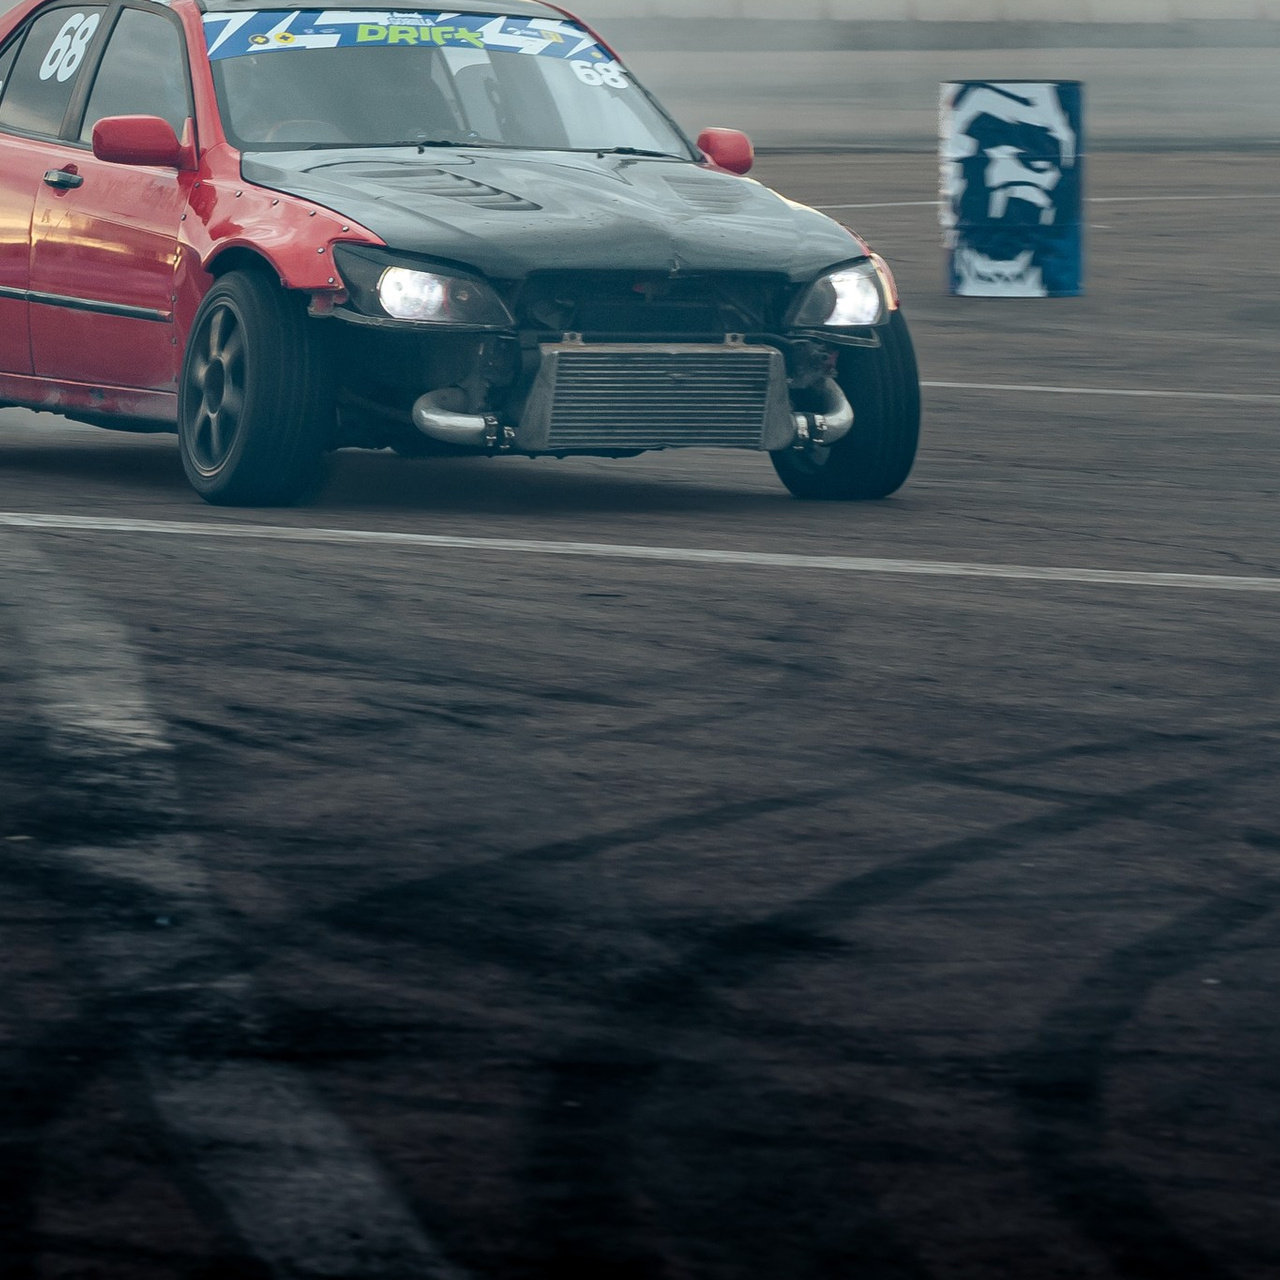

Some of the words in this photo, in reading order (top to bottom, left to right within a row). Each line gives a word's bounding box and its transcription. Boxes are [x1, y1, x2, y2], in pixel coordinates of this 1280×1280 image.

[39, 12, 100, 82] 68
[356, 24, 485, 49] DRIFT
[569, 60, 629, 89] 68
